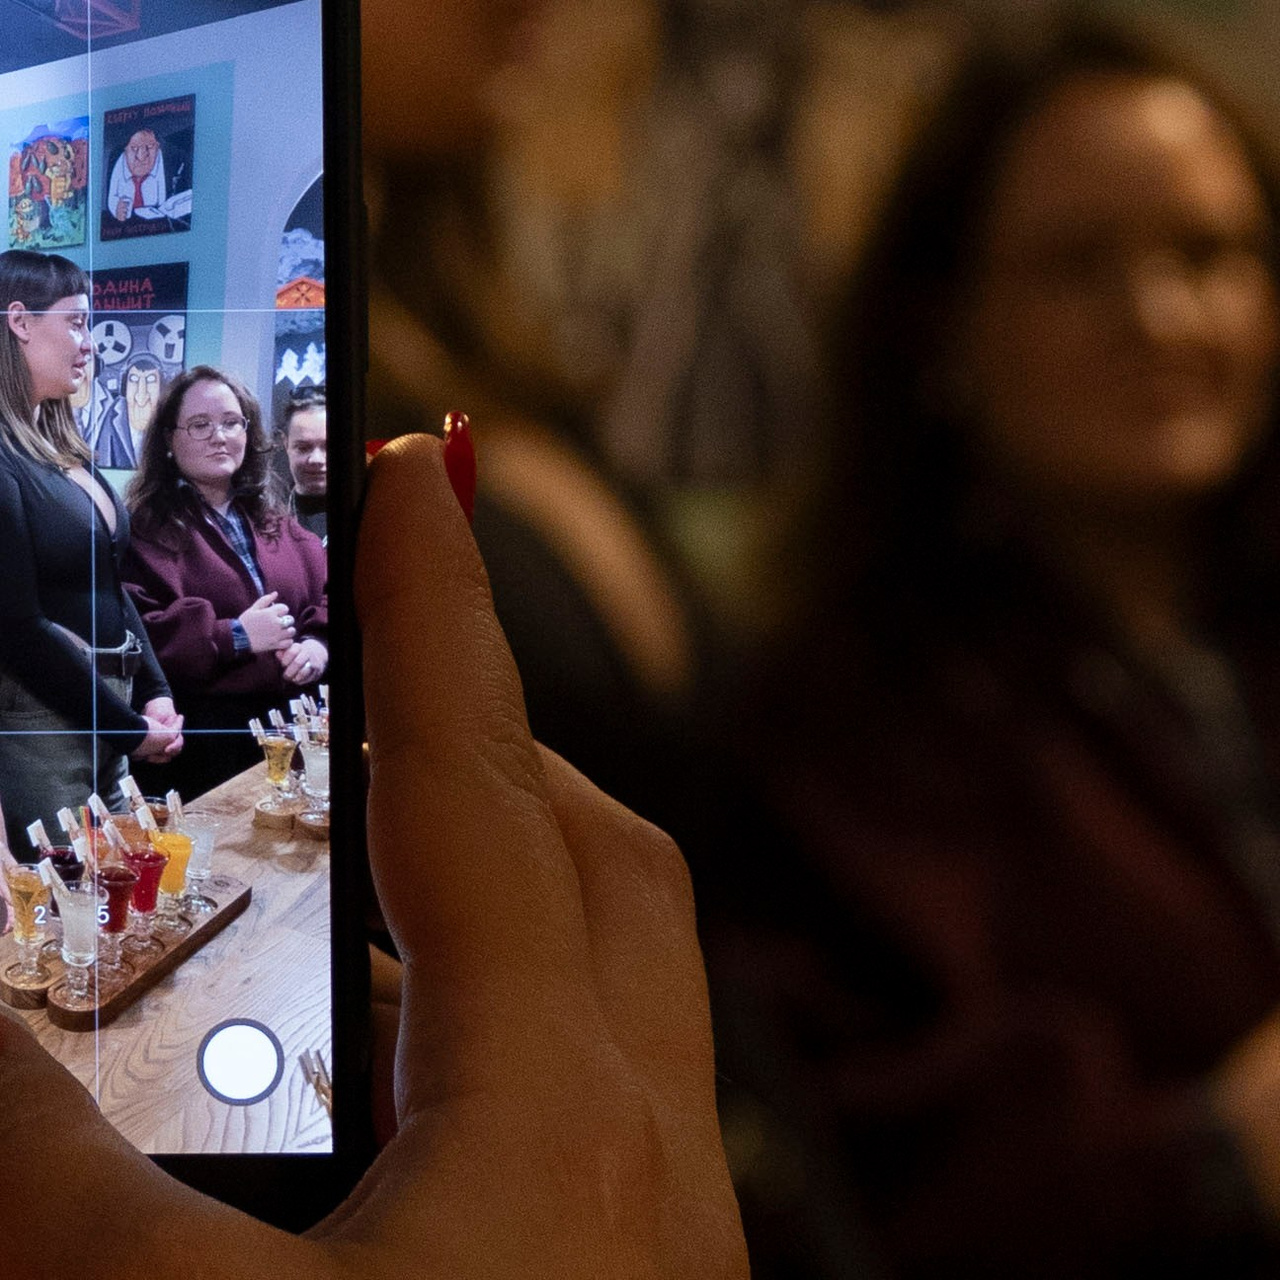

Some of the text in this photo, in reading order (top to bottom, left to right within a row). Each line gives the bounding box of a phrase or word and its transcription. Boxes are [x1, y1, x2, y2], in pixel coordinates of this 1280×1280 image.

[92, 276, 154, 296] ОДИНА
[93, 293, 155, 310] ЛЫШИТ
[34, 905, 47, 925] 2
[97, 905, 110, 925] 5
